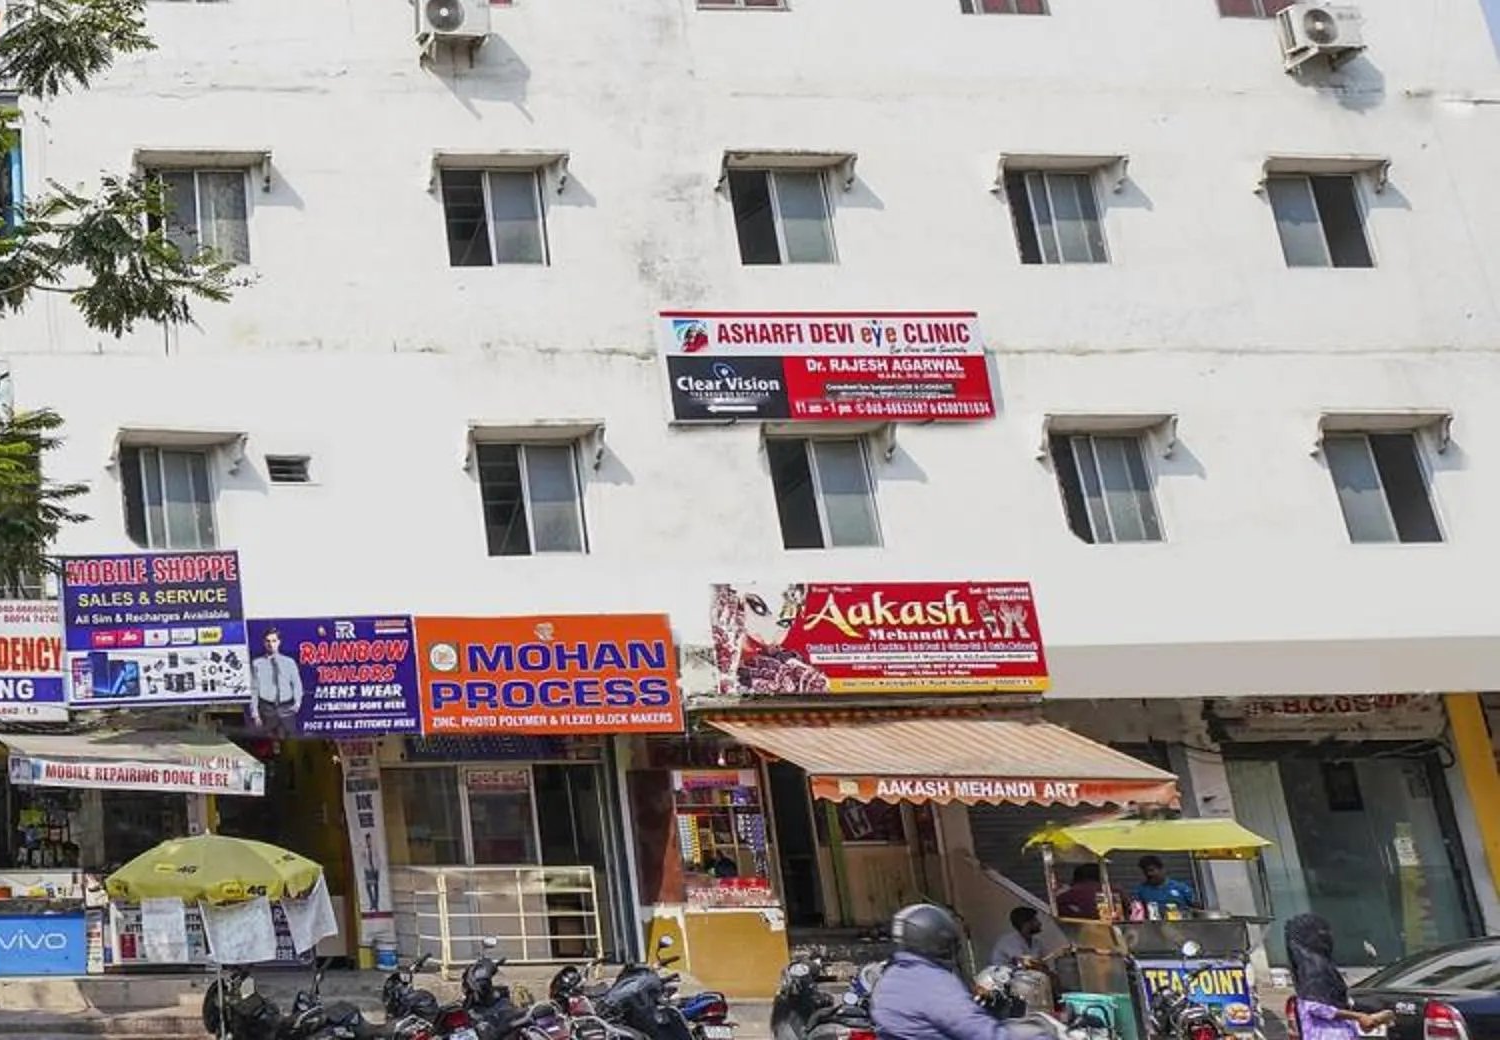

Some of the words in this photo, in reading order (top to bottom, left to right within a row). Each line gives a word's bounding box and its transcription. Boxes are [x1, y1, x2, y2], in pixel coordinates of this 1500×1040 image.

[717, 323, 803, 344] ASHARFI
[811, 324, 854, 344] DEVI
[903, 324, 970, 344] CLINIC
[806, 359, 827, 373] Dr.
[830, 359, 888, 372] RAJESH
[892, 360, 964, 372] AGARWAL
[677, 376, 717, 391] Clear
[725, 376, 780, 391] Vision
[66, 558, 148, 586] MOBILE
[153, 555, 238, 584] SHOPPE
[78, 591, 134, 607] SALES
[138, 591, 150, 605] &
[155, 588, 229, 605] SERVICE
[91, 614, 113, 624] Sim
[115, 613, 123, 623] &
[125, 612, 180, 624] Recharges
[183, 610, 231, 621] Available
[803, 589, 975, 638] Aakash
[868, 627, 949, 641] Mehandi
[954, 629, 986, 641] Art
[299, 640, 409, 664] RAINBOW
[467, 641, 666, 672] MOHAN
[317, 664, 397, 683] TAILORS
[314, 685, 357, 699] MENS
[361, 684, 403, 698] WEAR
[431, 678, 671, 710] PROCESS
[461, 716, 497, 727] PHOTO
[499, 715, 547, 726] POLYMER
[550, 715, 558, 726] &
[560, 714, 592, 725] FLEXO
[595, 714, 629, 725] BLOCK
[630, 713, 673, 724] MAKERS
[45, 764, 90, 781] MOBILE
[95, 766, 159, 783] REPAIRING
[163, 770, 195, 785] DONE
[199, 771, 229, 787] HERE
[877, 778, 950, 798] AAKASH
[954, 780, 1036, 799] MEHANDI
[1043, 782, 1079, 799] ART
[247, 885, 268, 897] 4G
[1145, 969, 1183, 995] TEA
[1188, 969, 1245, 996] POINT
